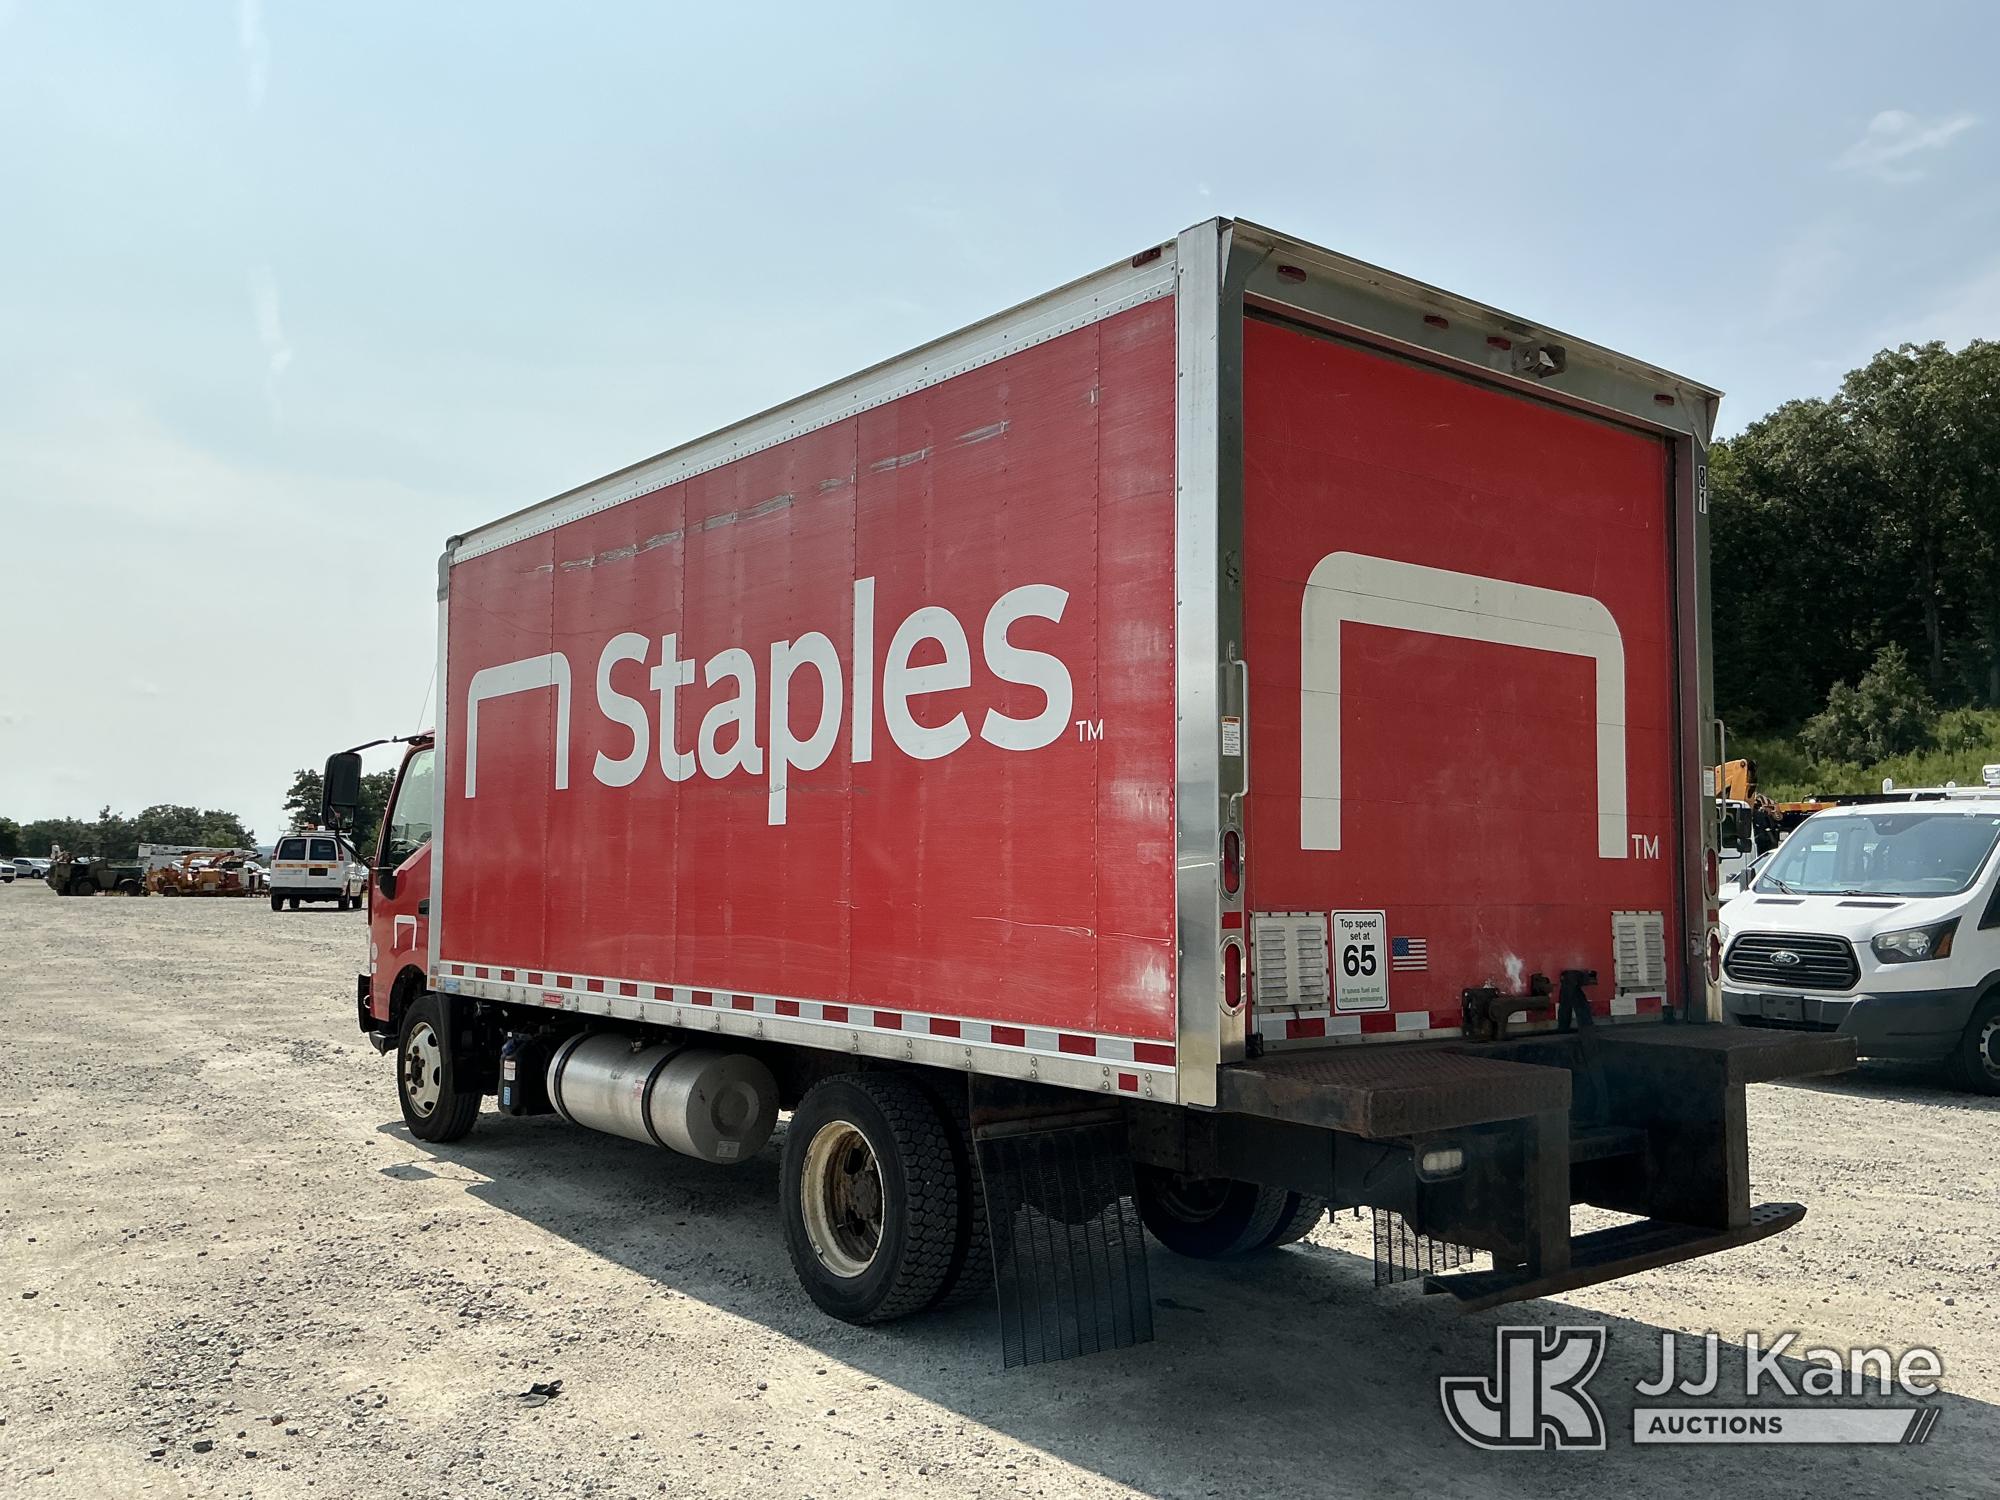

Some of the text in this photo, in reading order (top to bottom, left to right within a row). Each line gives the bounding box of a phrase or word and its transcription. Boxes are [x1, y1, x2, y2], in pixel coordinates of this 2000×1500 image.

[592, 576, 1074, 826] Staples
[1075, 718, 1104, 742] TM
[1631, 834, 1659, 860] TM
[1339, 918, 1377, 930] Top speed
[1350, 932, 1370, 941] set at
[1343, 944, 1377, 977] 65
